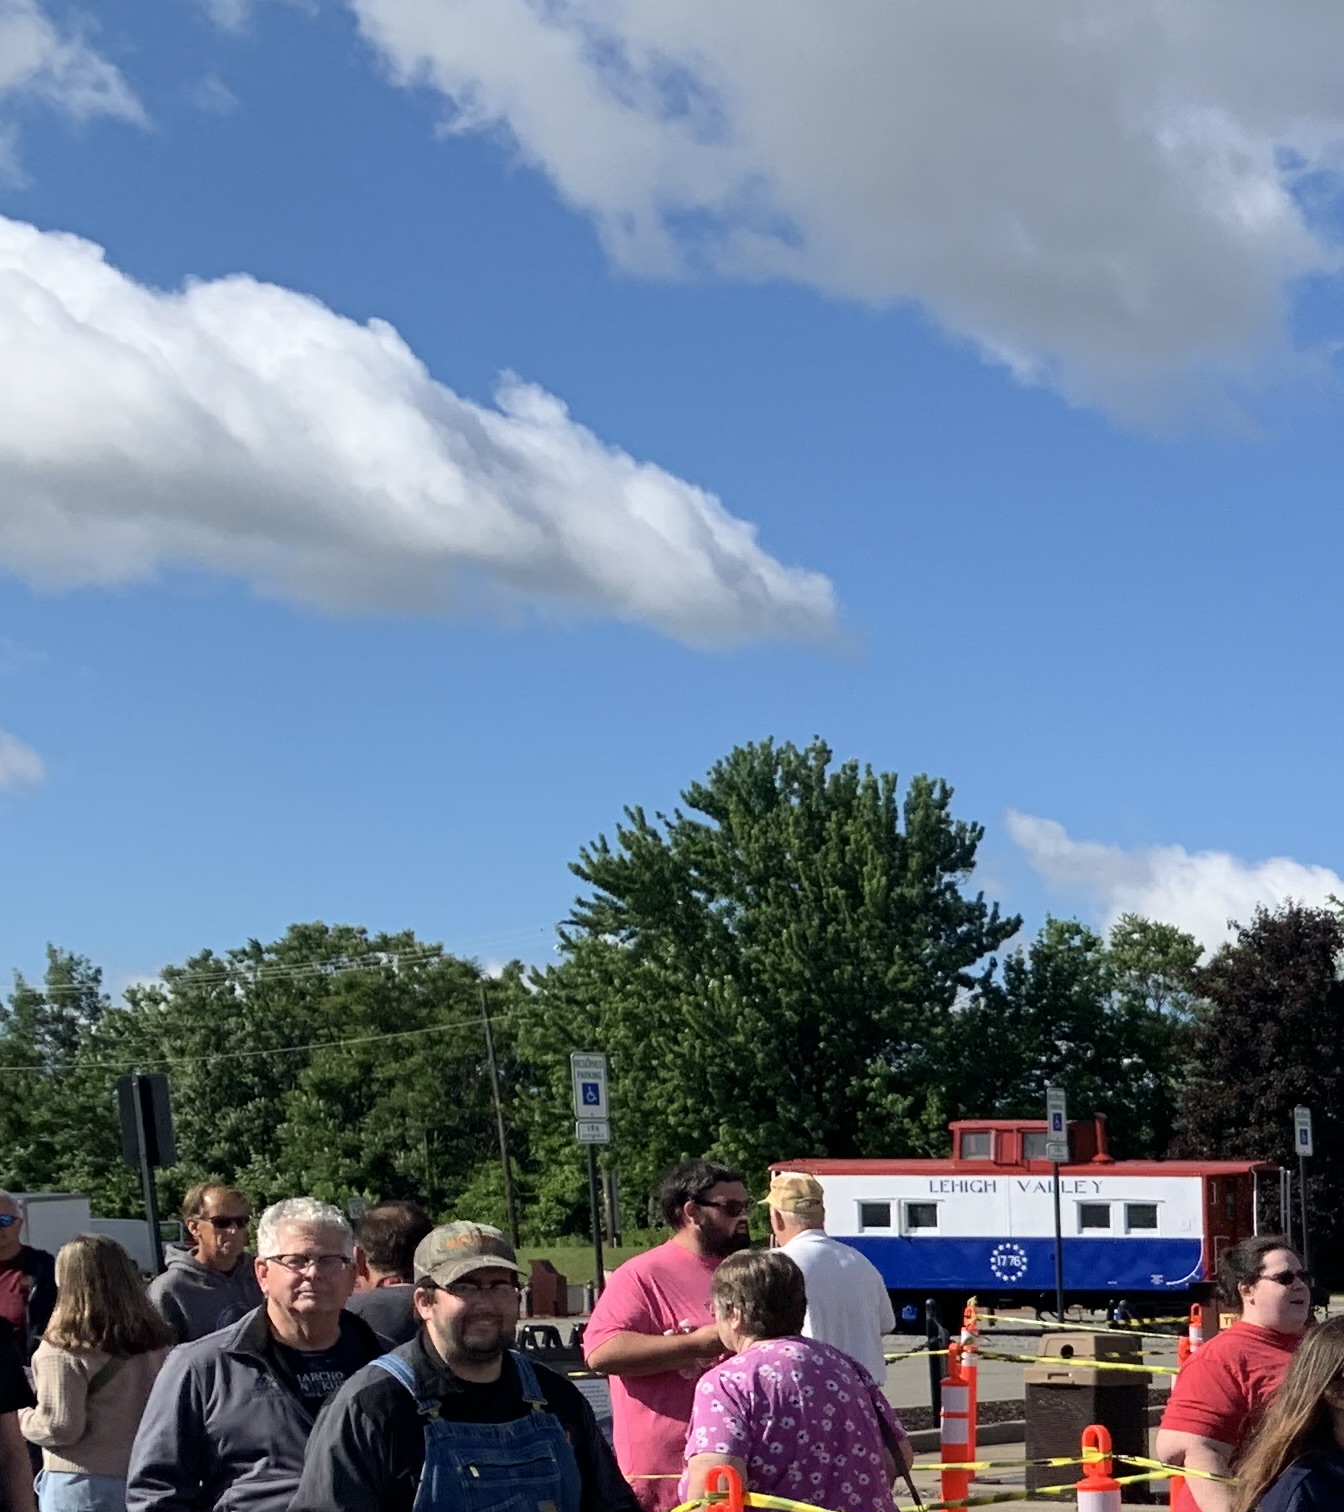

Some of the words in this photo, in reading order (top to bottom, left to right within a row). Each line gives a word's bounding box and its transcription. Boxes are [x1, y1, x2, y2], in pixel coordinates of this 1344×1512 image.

[929, 1180, 997, 1193] LEHIGH
[1017, 1180, 1104, 1194] VALLEY
[997, 1255, 1021, 1267] 1776
